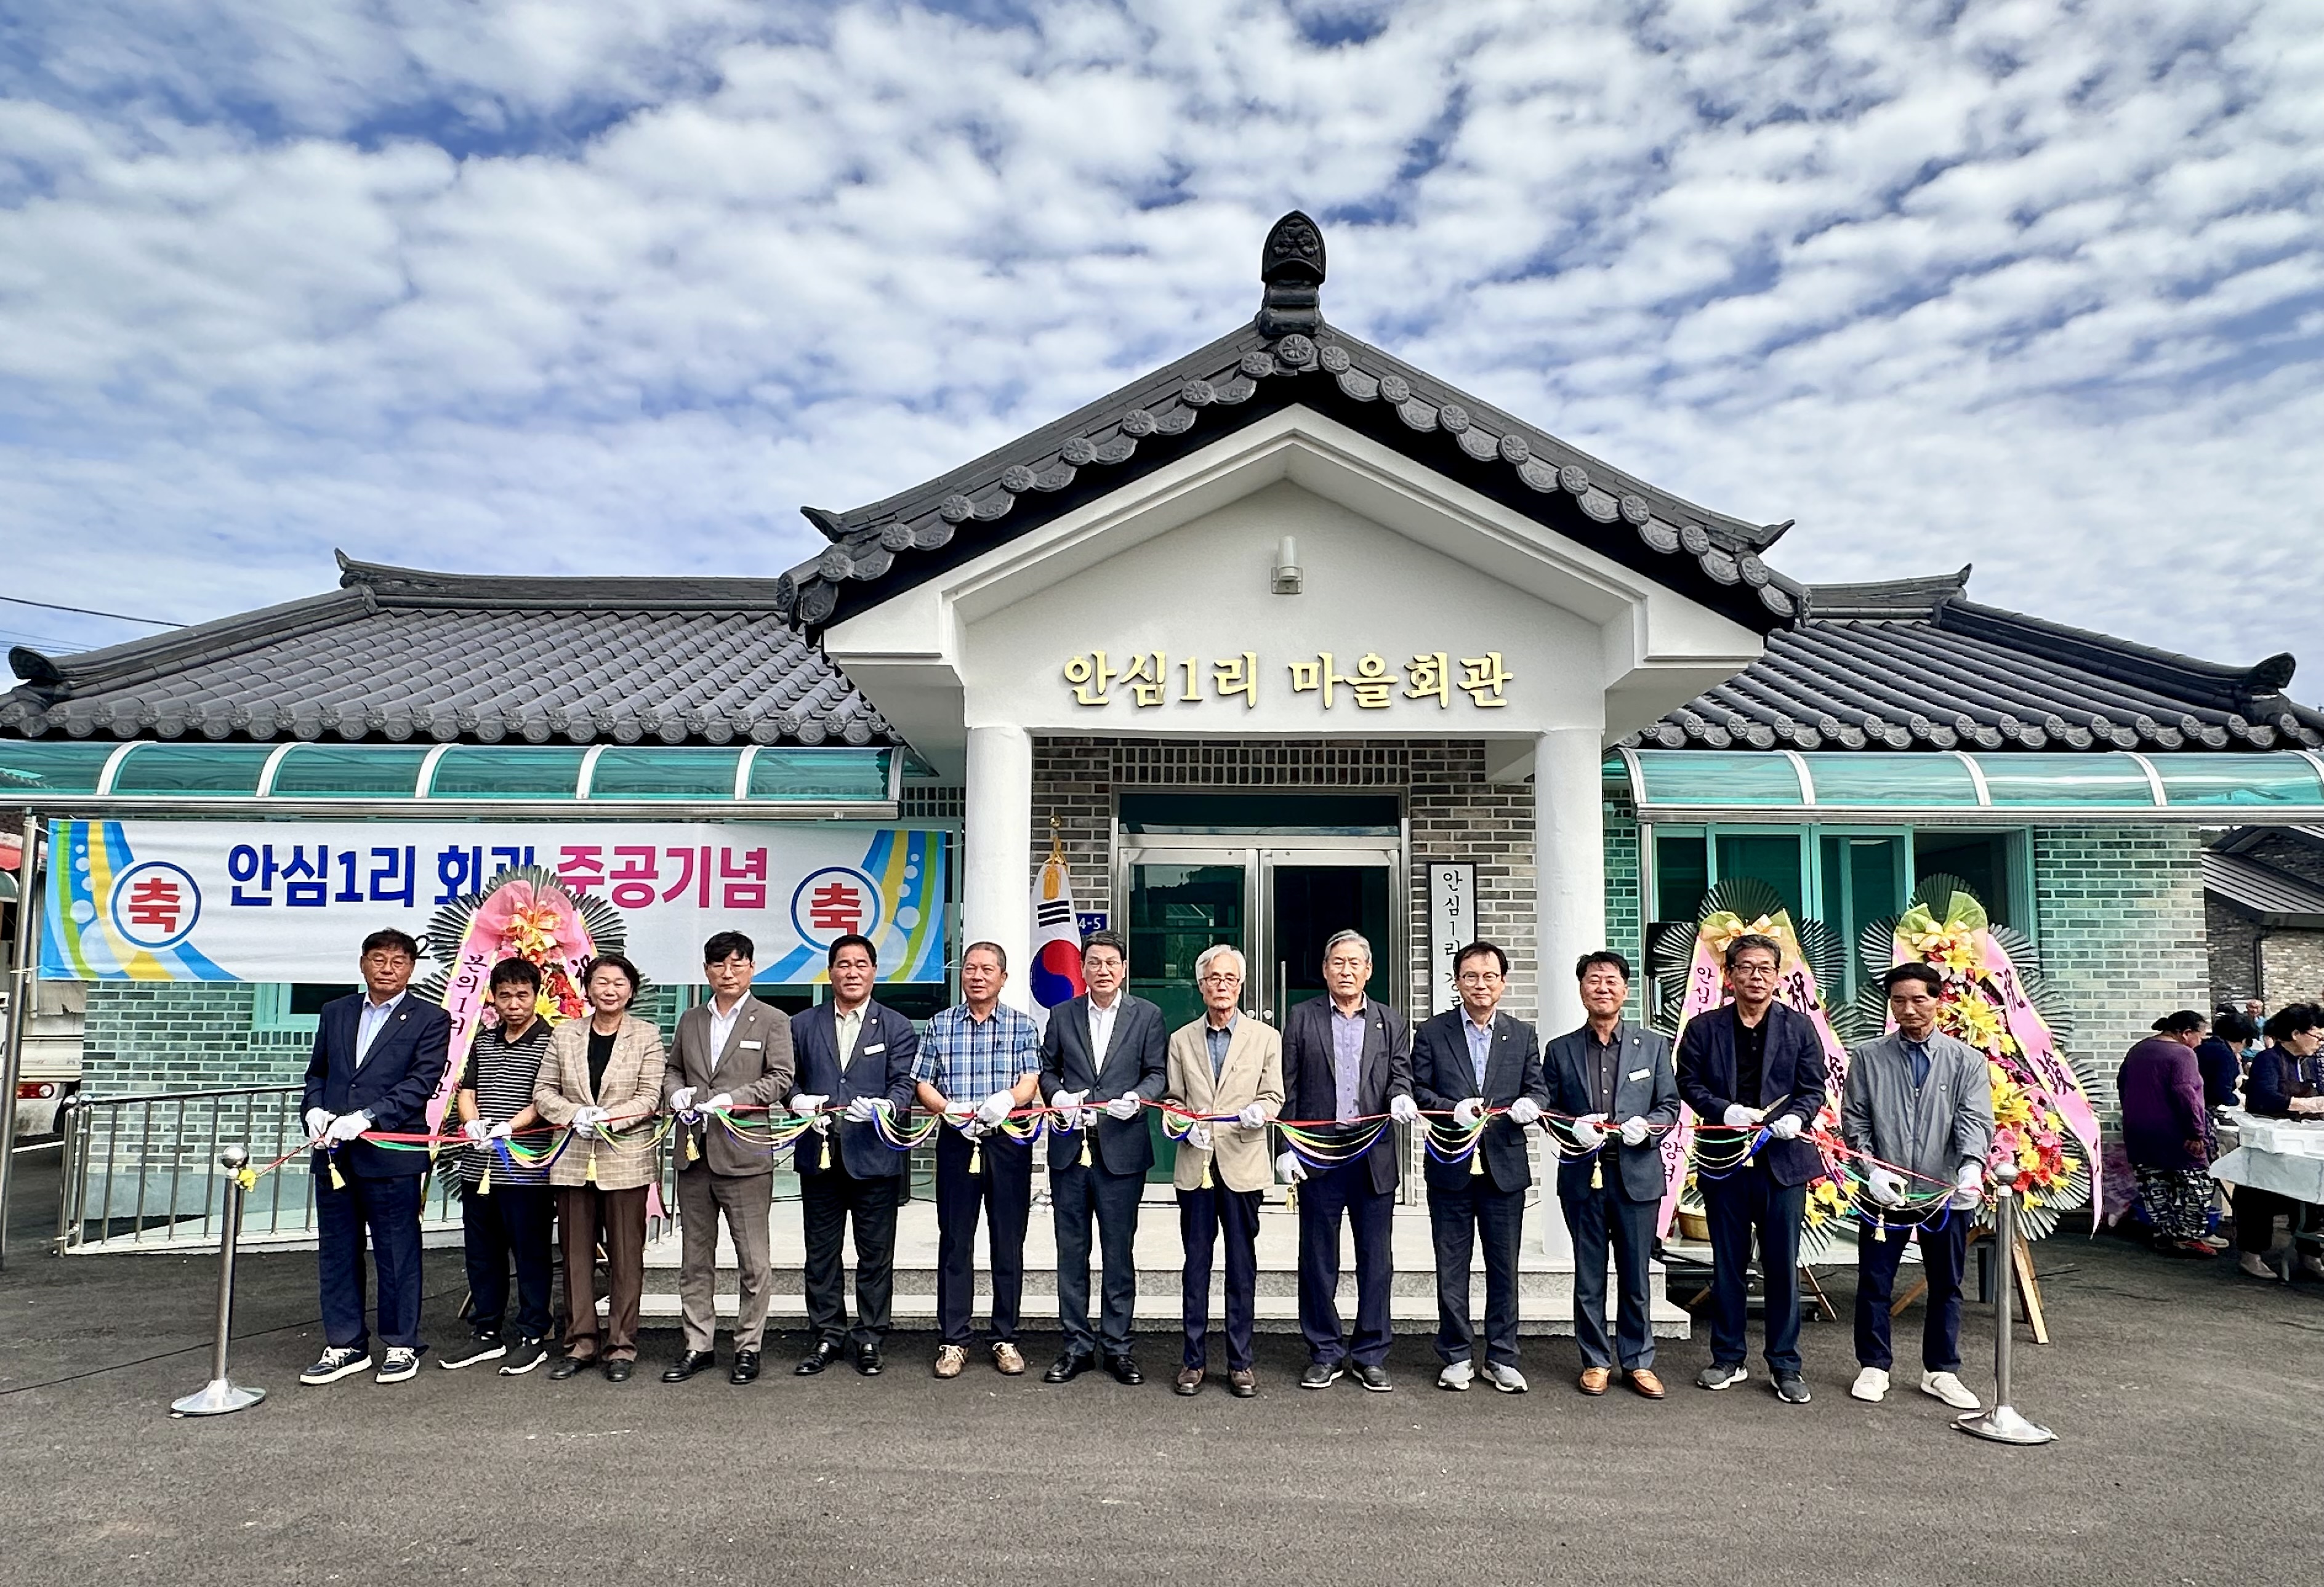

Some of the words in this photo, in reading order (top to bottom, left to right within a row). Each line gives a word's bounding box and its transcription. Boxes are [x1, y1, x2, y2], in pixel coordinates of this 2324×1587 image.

[1064, 650, 1256, 707] 안심1리
[1289, 653, 1512, 708] 마을회관
[129, 878, 180, 932] 축
[228, 845, 416, 907] 안심1리
[810, 883, 862, 934] 축
[1443, 870, 1463, 955] 안심1리
